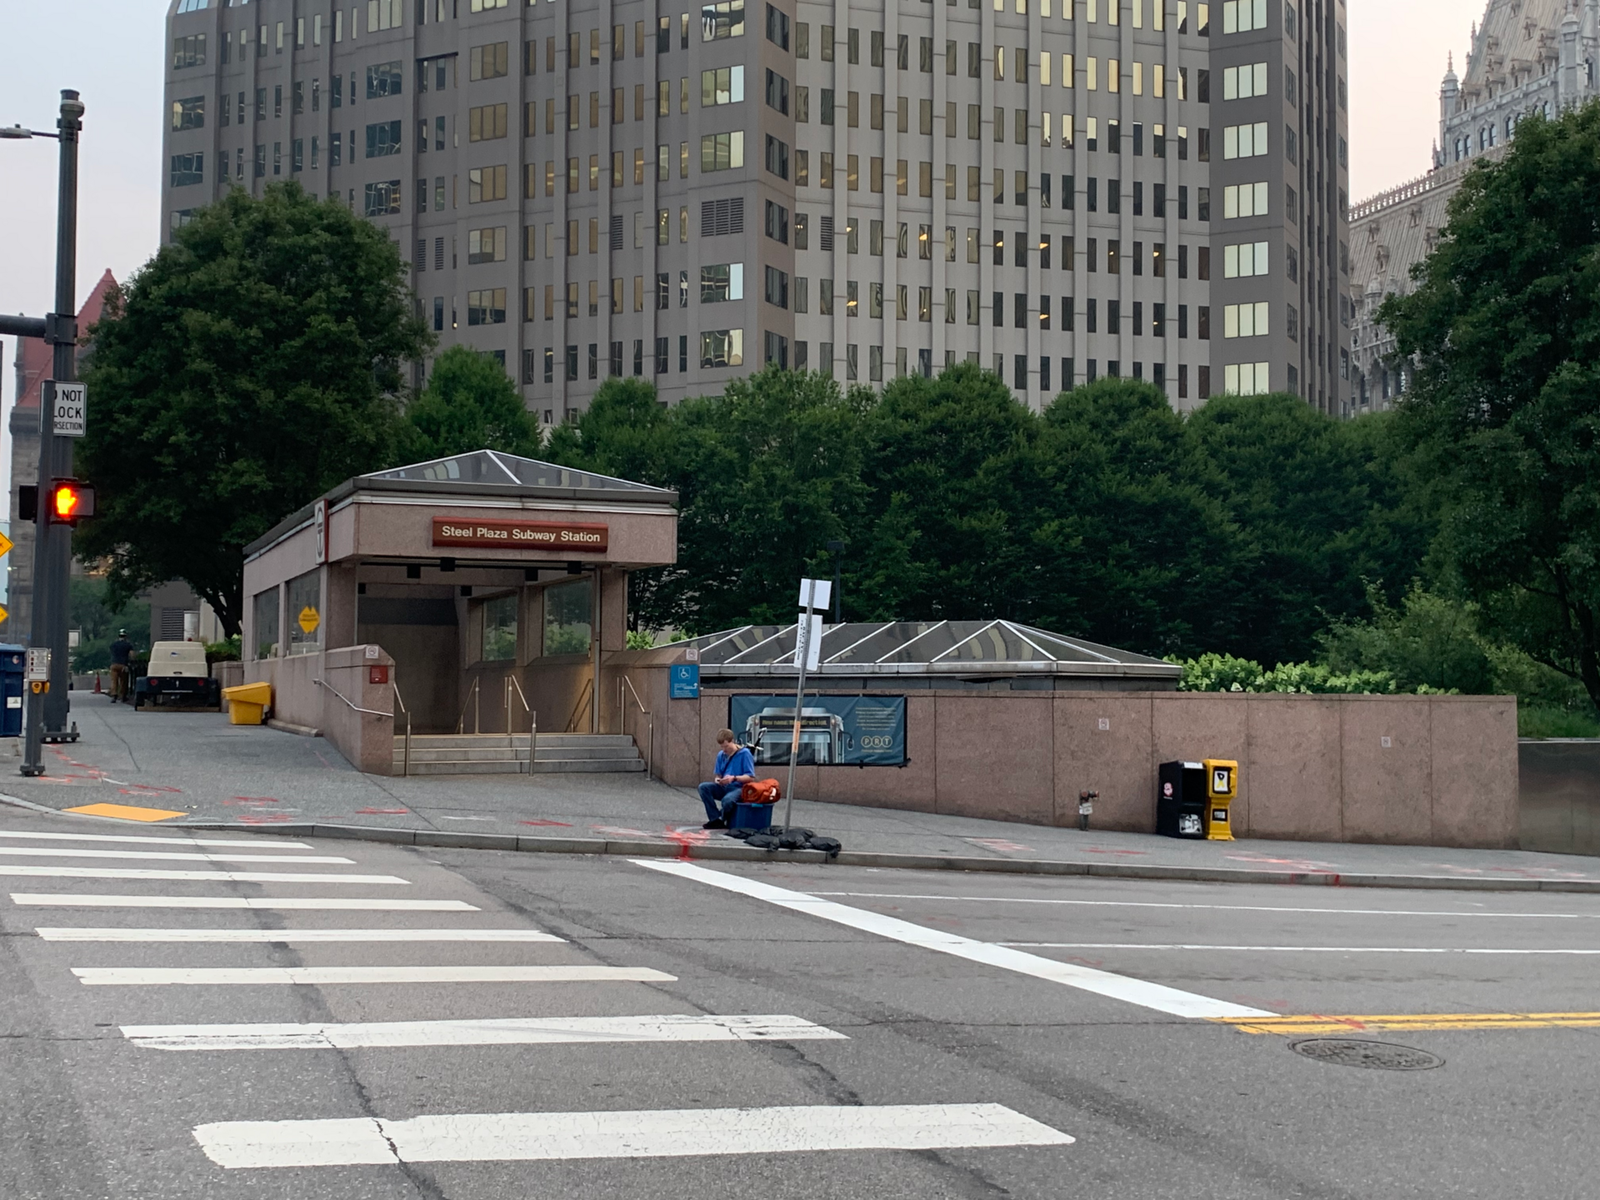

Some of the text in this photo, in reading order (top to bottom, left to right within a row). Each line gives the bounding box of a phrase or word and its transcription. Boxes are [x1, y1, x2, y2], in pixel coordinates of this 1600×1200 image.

[61, 389, 83, 402] NOT
[442, 525, 601, 543] Steel Plaza Subway Station
